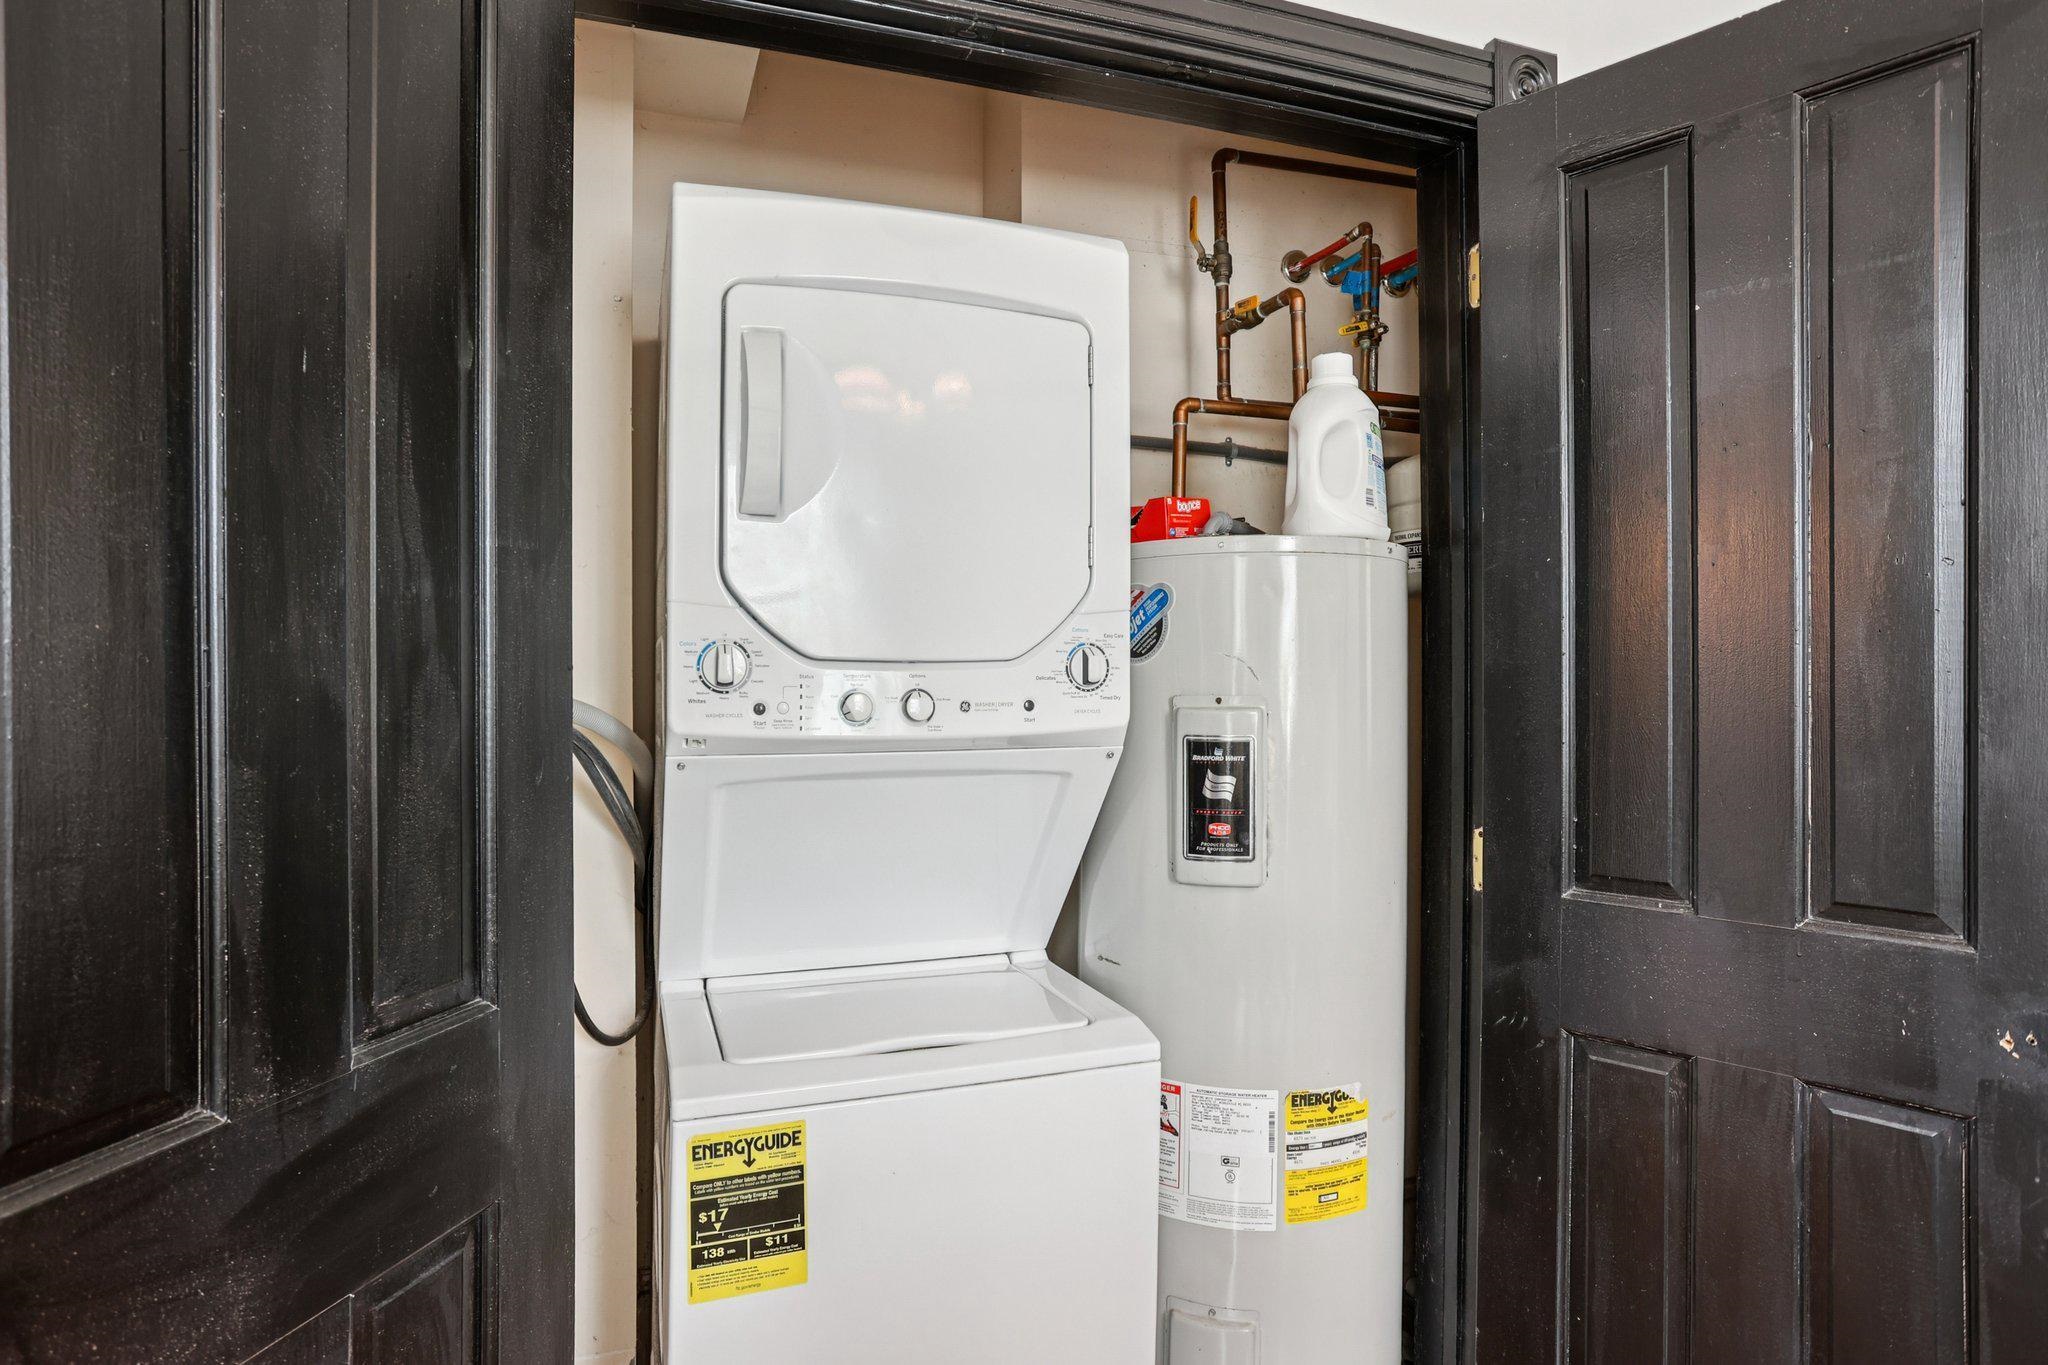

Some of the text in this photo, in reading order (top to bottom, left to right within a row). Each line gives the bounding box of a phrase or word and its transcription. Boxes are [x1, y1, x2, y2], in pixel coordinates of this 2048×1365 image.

[1177, 500, 1201, 512] bounce
[1291, 1090, 1354, 1109] ENERGYGU
[692, 1130, 801, 1163] ENERGYGUIDE
[714, 1180, 726, 1188] ONLY
[768, 1172, 781, 1180] yellow
[718, 1195, 739, 1203] Estimated
[698, 1208, 728, 1224] $17
[765, 1234, 788, 1247] $11
[702, 1247, 725, 1260] 138
